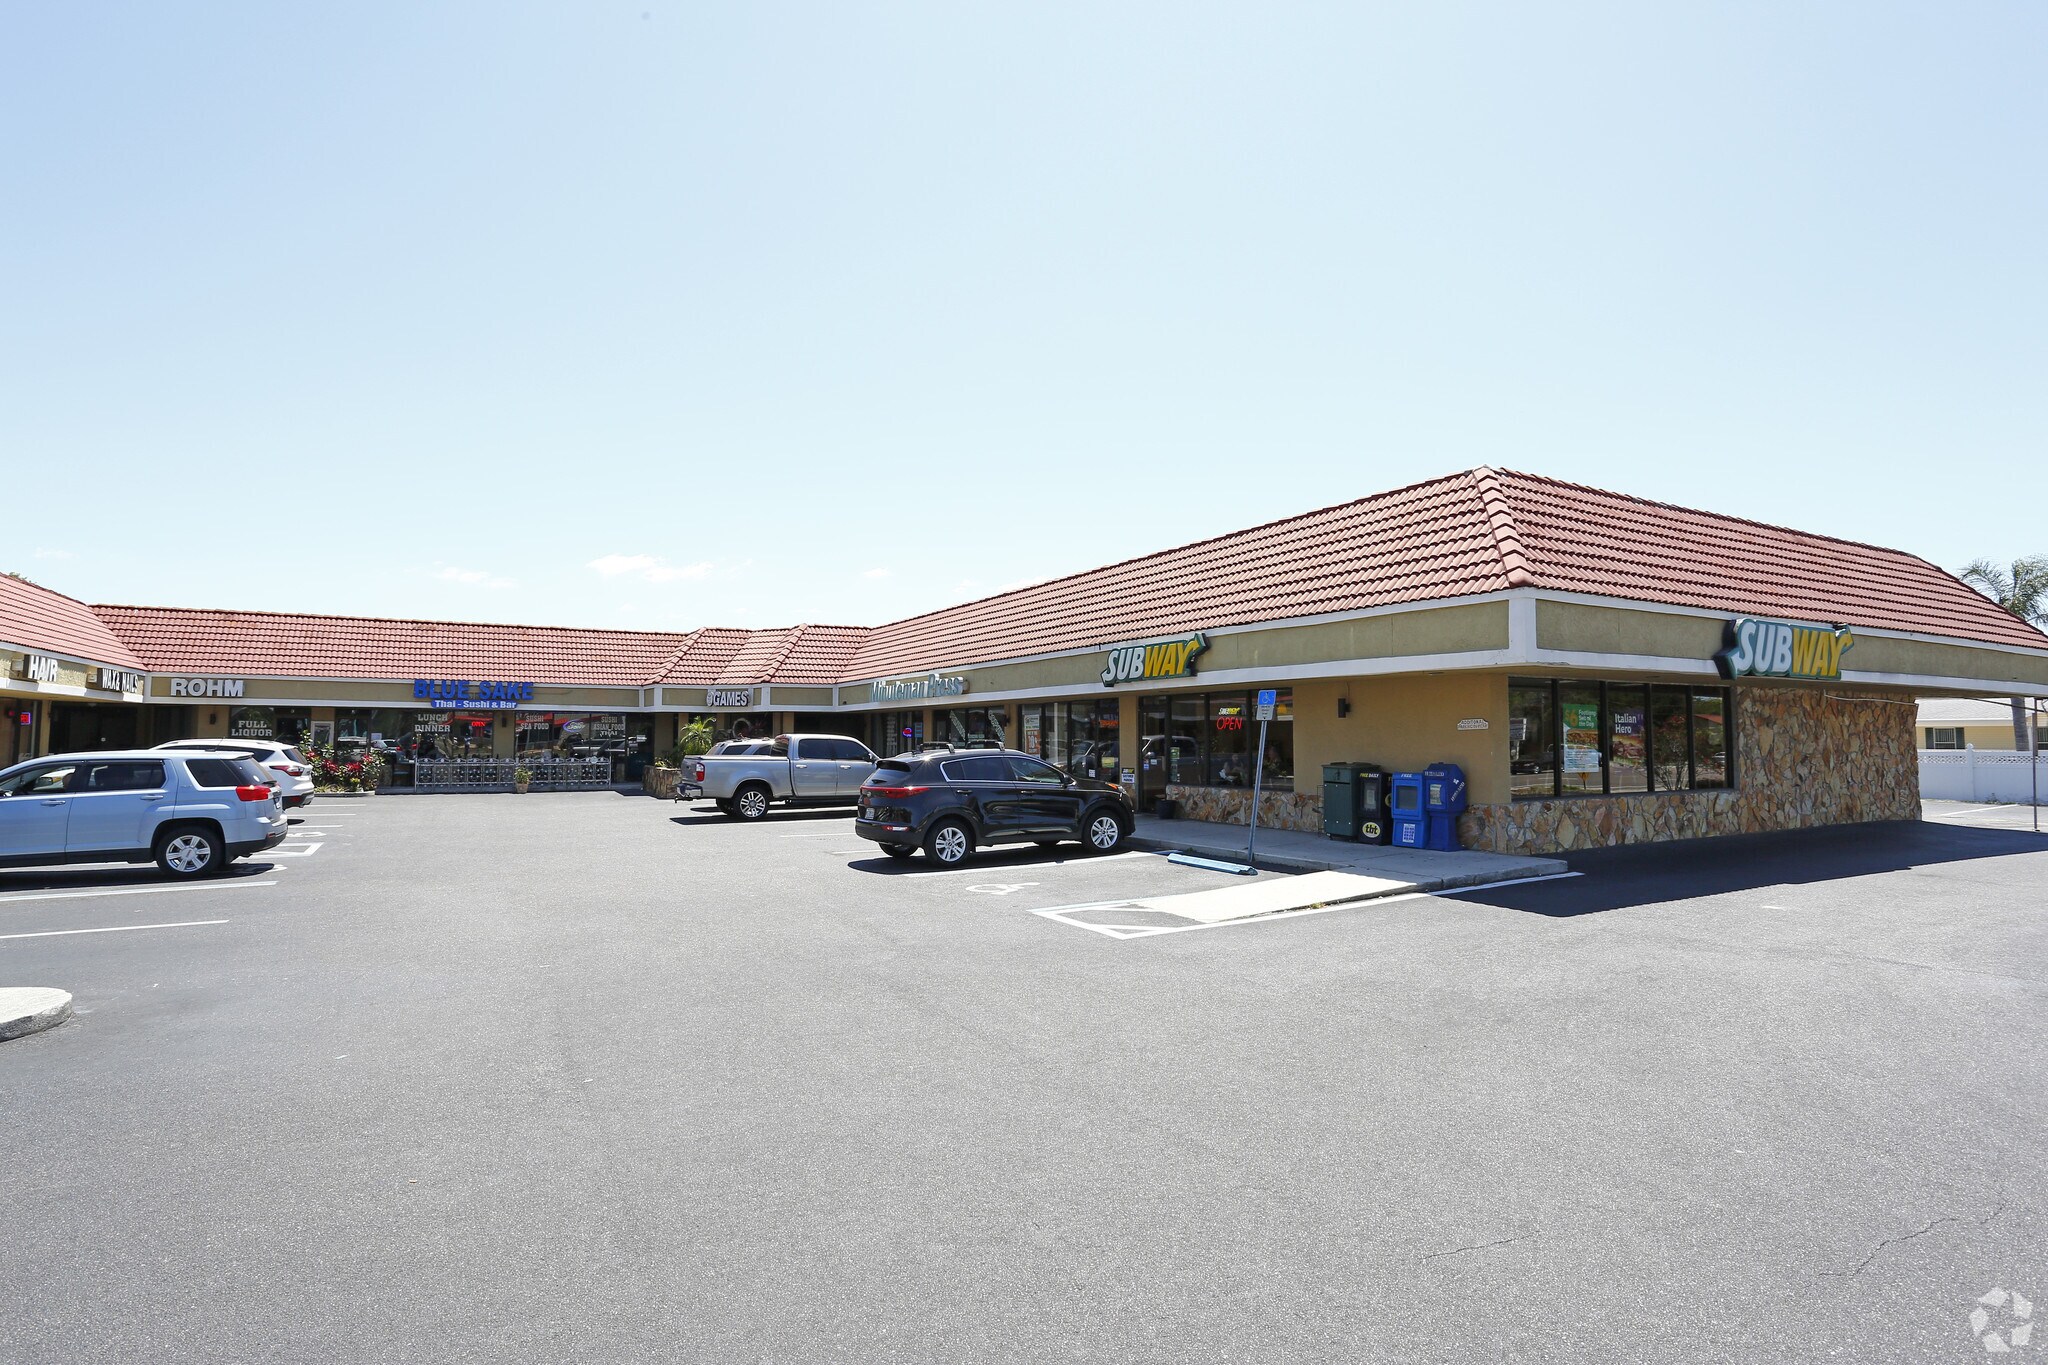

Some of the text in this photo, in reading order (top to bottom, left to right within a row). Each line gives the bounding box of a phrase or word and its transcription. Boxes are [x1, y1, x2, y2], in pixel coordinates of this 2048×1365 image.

[1731, 621, 1853, 677] SUBWAY
[28, 655, 58, 682] HAIR
[1102, 640, 1199, 682] SUBWAY
[122, 672, 139, 693] NAILS
[170, 678, 244, 697] ROHM
[414, 679, 534, 700] BLUE SAKE
[871, 673, 964, 702] Minuteman Press
[435, 700, 456, 708] Thai
[463, 700, 490, 708] Sushi
[500, 701, 517, 709] Bar
[713, 690, 749, 707] GAMES
[238, 720, 267, 729] FULL
[417, 713, 448, 721] LUNCH
[1216, 716, 1243, 731] OPEN
[1615, 713, 1637, 723] Italian
[231, 728, 273, 737] LIQUOR
[414, 724, 451, 732] DINNER
[520, 722, 549, 730] SEA FOOD
[1615, 724, 1632, 733] Hero
